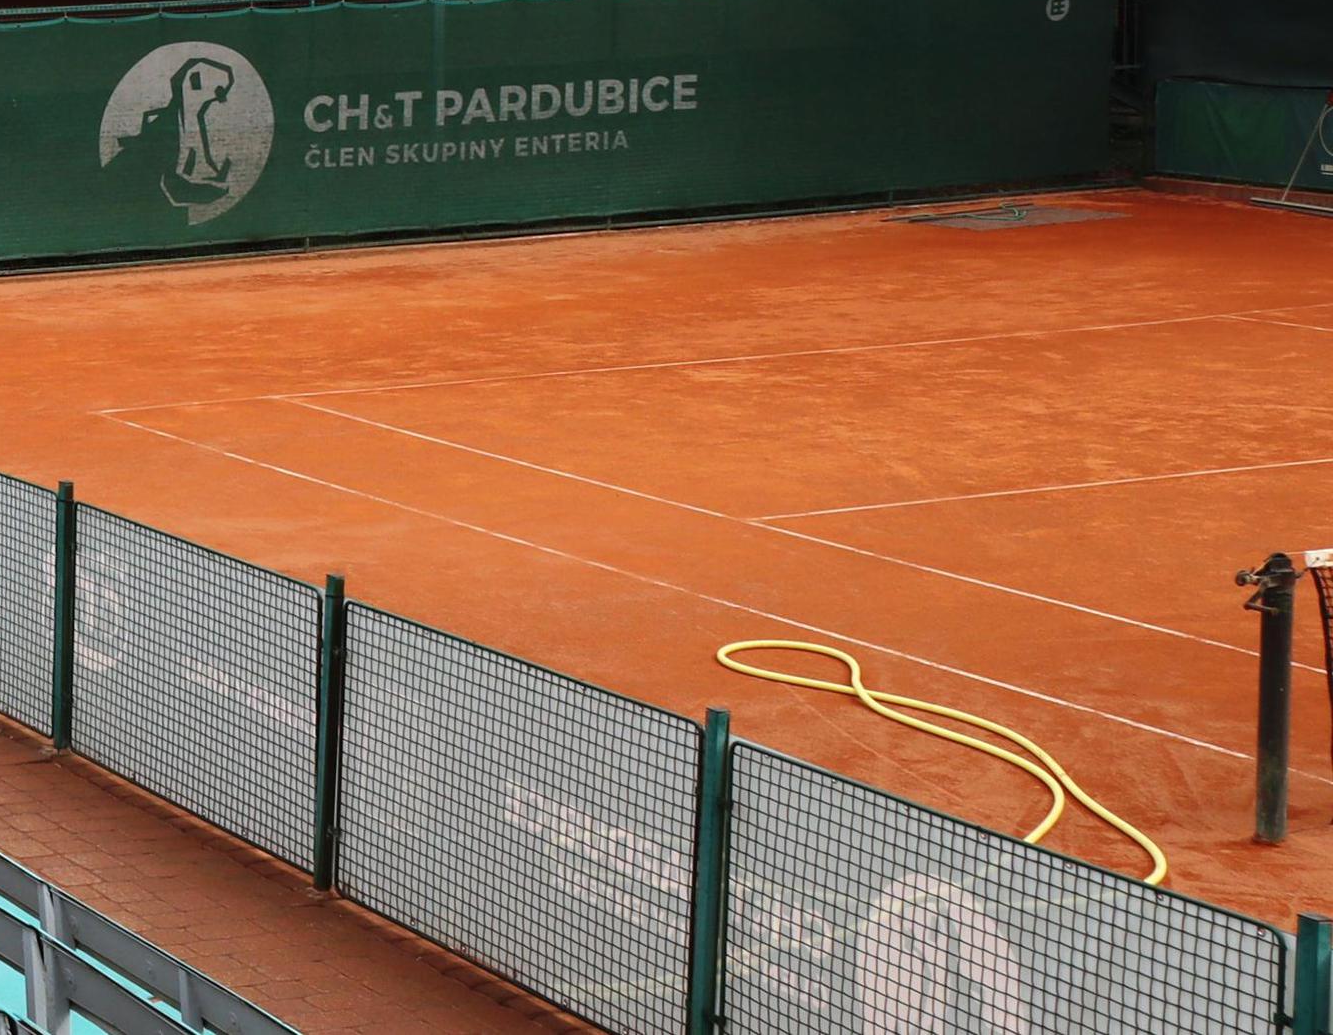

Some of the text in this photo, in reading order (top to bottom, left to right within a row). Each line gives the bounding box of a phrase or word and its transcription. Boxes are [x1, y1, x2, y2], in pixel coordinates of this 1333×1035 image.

[303, 73, 699, 135] CH&T PARDUBICE
[304, 129, 630, 169] ČLEN SKUPINY ENTERIA
